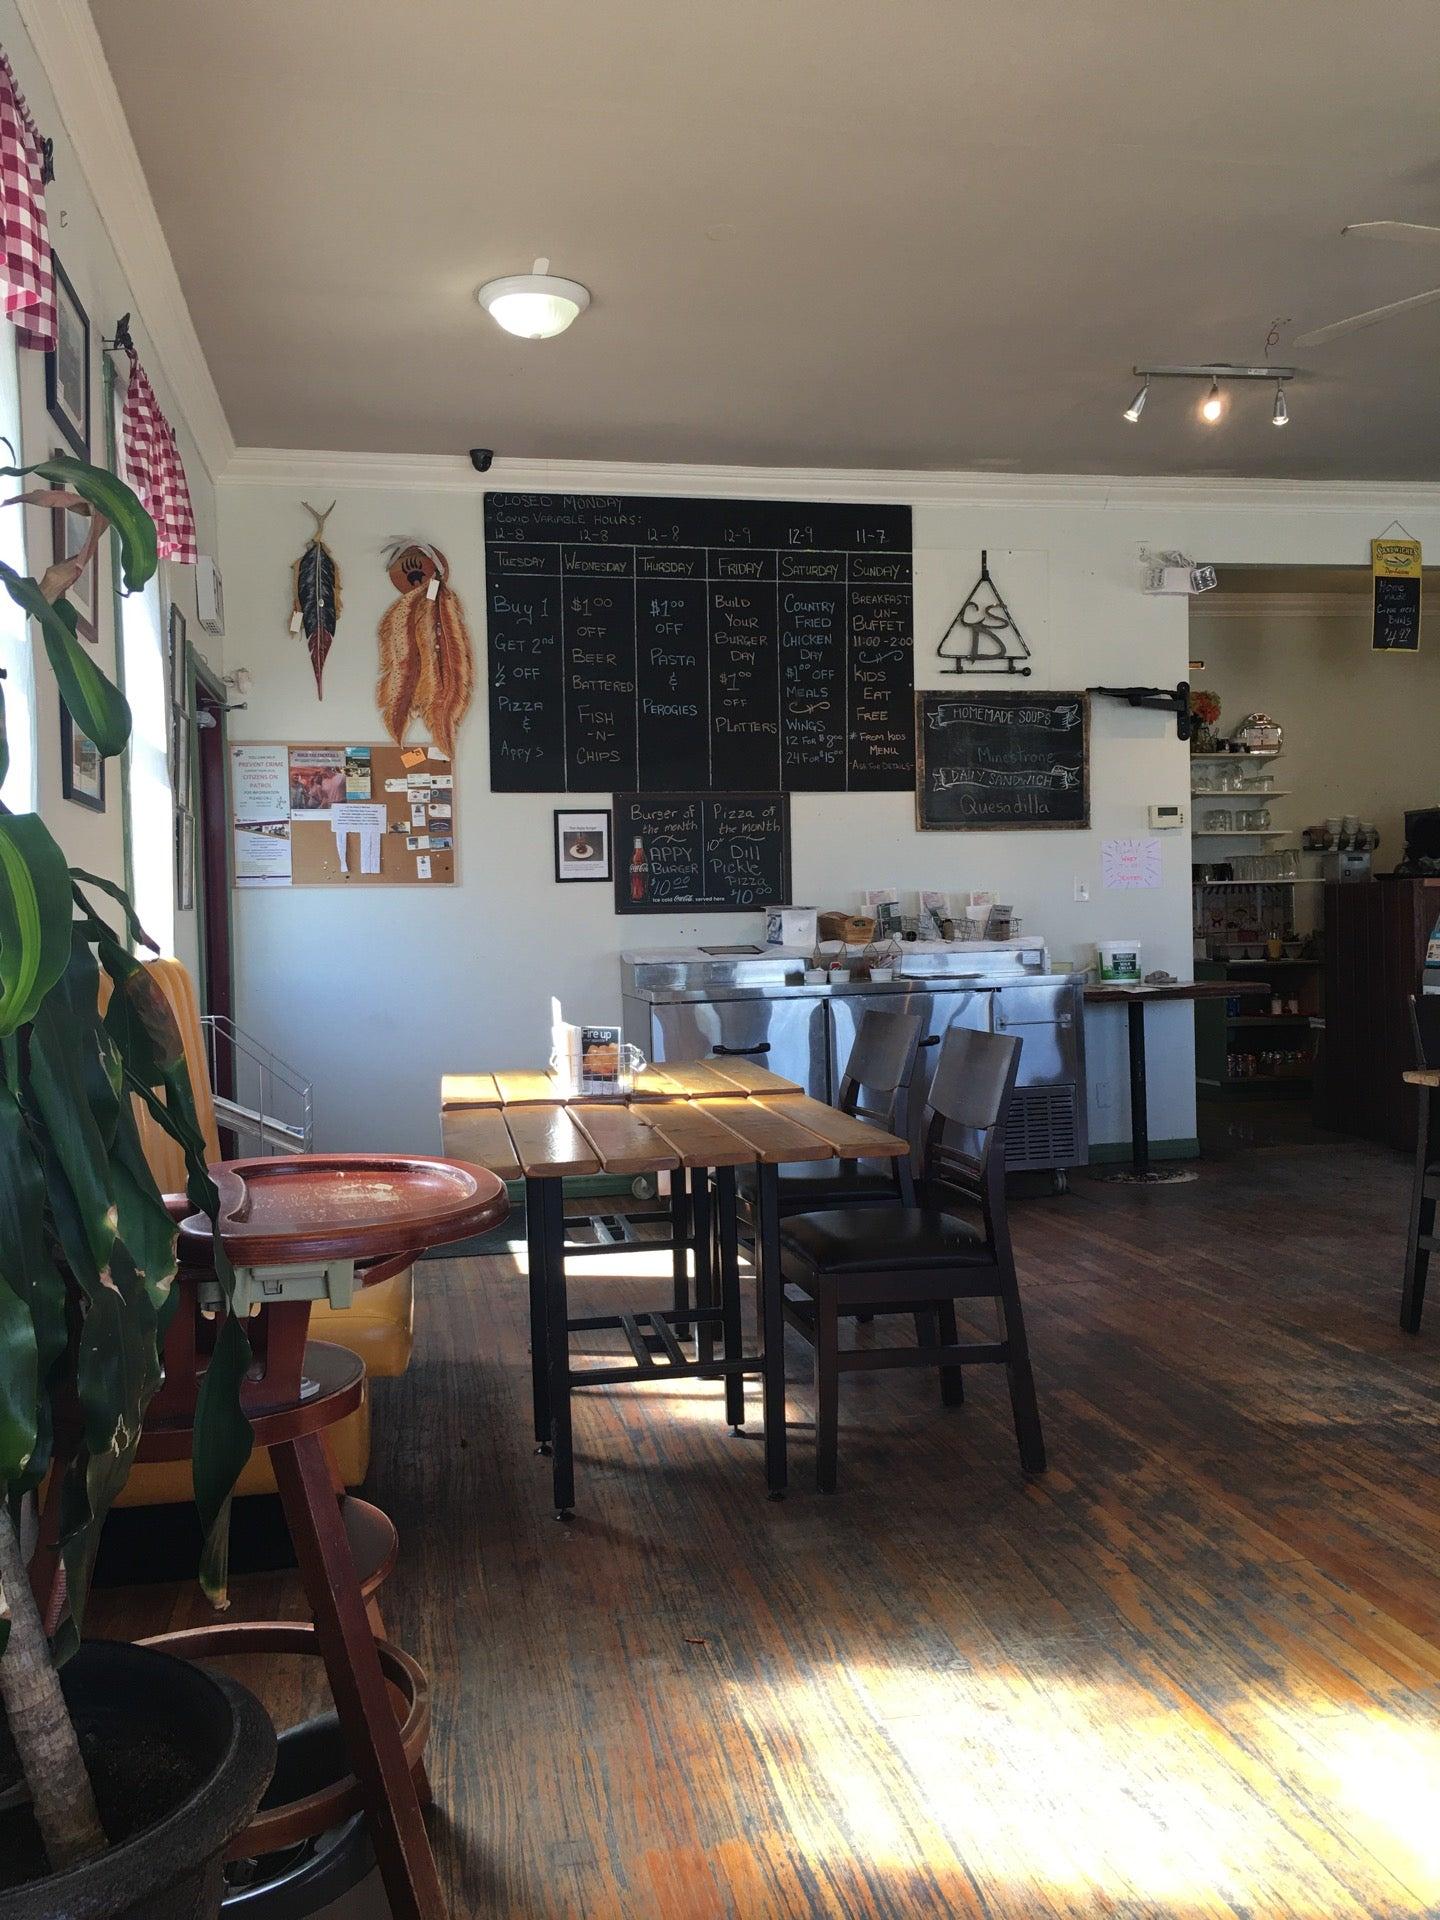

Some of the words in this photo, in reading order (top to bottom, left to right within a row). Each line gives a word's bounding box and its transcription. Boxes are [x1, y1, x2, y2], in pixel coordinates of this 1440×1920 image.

[563, 495, 623, 512] MONDAY
[533, 514, 585, 524] VARIABLE
[494, 551, 546, 568] TUESDAY
[564, 552, 626, 572] WEDNESDAY
[639, 556, 696, 573] THURSDAY
[719, 557, 764, 578] FRIDAY
[782, 557, 839, 577] SATURDAY
[853, 559, 900, 578] SUNDAY
[715, 595, 750, 608] BUILD
[784, 594, 835, 613] COUNTRY
[852, 593, 911, 605] BREAKFAST
[725, 613, 759, 628] YOUR
[795, 616, 832, 628] FRIED
[853, 617, 904, 631] BUFFET
[577, 626, 608, 638] OFF
[656, 623, 684, 635] OFF
[495, 633, 525, 652] GET
[715, 632, 767, 645] BURGER
[783, 632, 832, 645] CHICKEN
[572, 648, 617, 666] BEER
[650, 648, 696, 666] PASTA
[731, 651, 755, 665] DAY
[800, 650, 823, 661] DAY
[513, 668, 541, 680] OFF
[812, 670, 834, 680] OFF
[854, 664, 886, 682] KIDS
[572, 675, 634, 693] BATTERED
[786, 687, 828, 697] MEALS
[863, 689, 891, 700] EAT
[499, 697, 543, 712] PIZZA
[643, 698, 698, 716] PEROGIES
[724, 699, 747, 707] OFF
[578, 704, 614, 725] FISH
[856, 708, 888, 721] FREE
[953, 707, 1014, 724] HOMEMADE
[1019, 710, 1051, 725] SOUPS
[715, 717, 777, 733] PLATTERS
[786, 719, 825, 731] WINGS
[786, 736, 799, 745] 12
[802, 736, 817, 745] FOR
[860, 733, 885, 741] FROM
[887, 732, 906, 741] KIDS
[576, 748, 621, 764] CHIPS
[870, 744, 899, 755] MENU
[978, 748, 1055, 763] Minestrone
[786, 752, 800, 763] 24
[952, 771, 985, 783] DAILY
[988, 774, 1052, 786] SANDWICH
[714, 803, 755, 819] Pizza
[762, 806, 776, 817] of
[960, 794, 1050, 815] Quesadilla
[631, 804, 677, 820] Burger
[683, 805, 696, 819] of
[642, 825, 659, 834] the
[719, 823, 736, 834] the
[650, 847, 693, 862] APPY
[651, 863, 698, 875] BURGER
[600, 1031, 611, 1041] up
